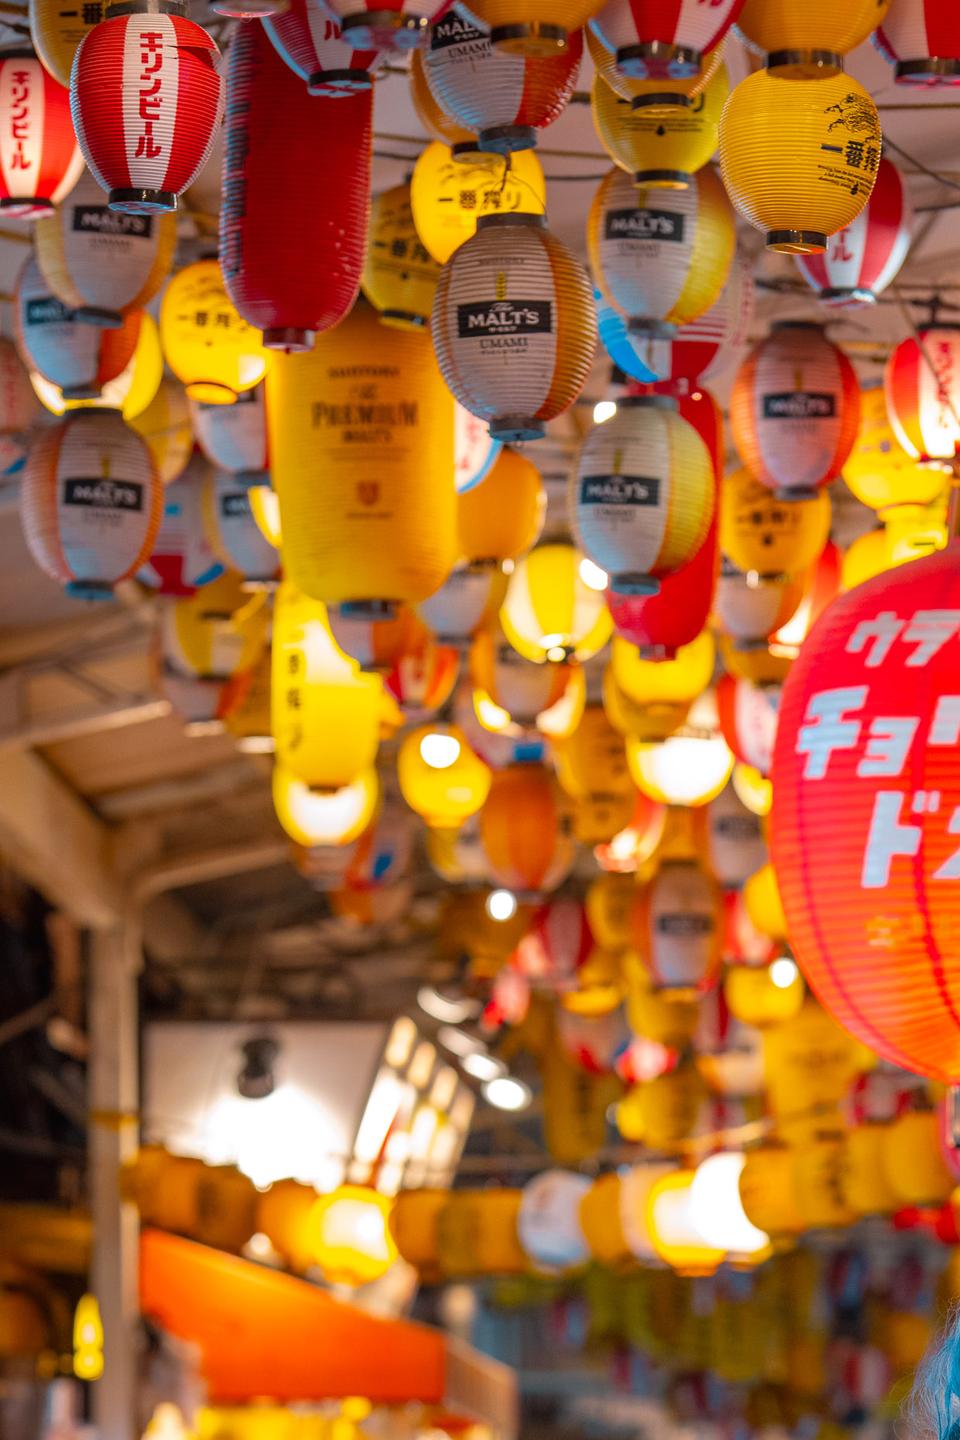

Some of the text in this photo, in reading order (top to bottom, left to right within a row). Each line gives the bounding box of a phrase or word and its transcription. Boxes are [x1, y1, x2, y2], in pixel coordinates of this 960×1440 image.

[11, 71, 32, 171] キリンビール
[135, 32, 163, 159] キリンビール
[467, 308, 540, 329] MALT'S
